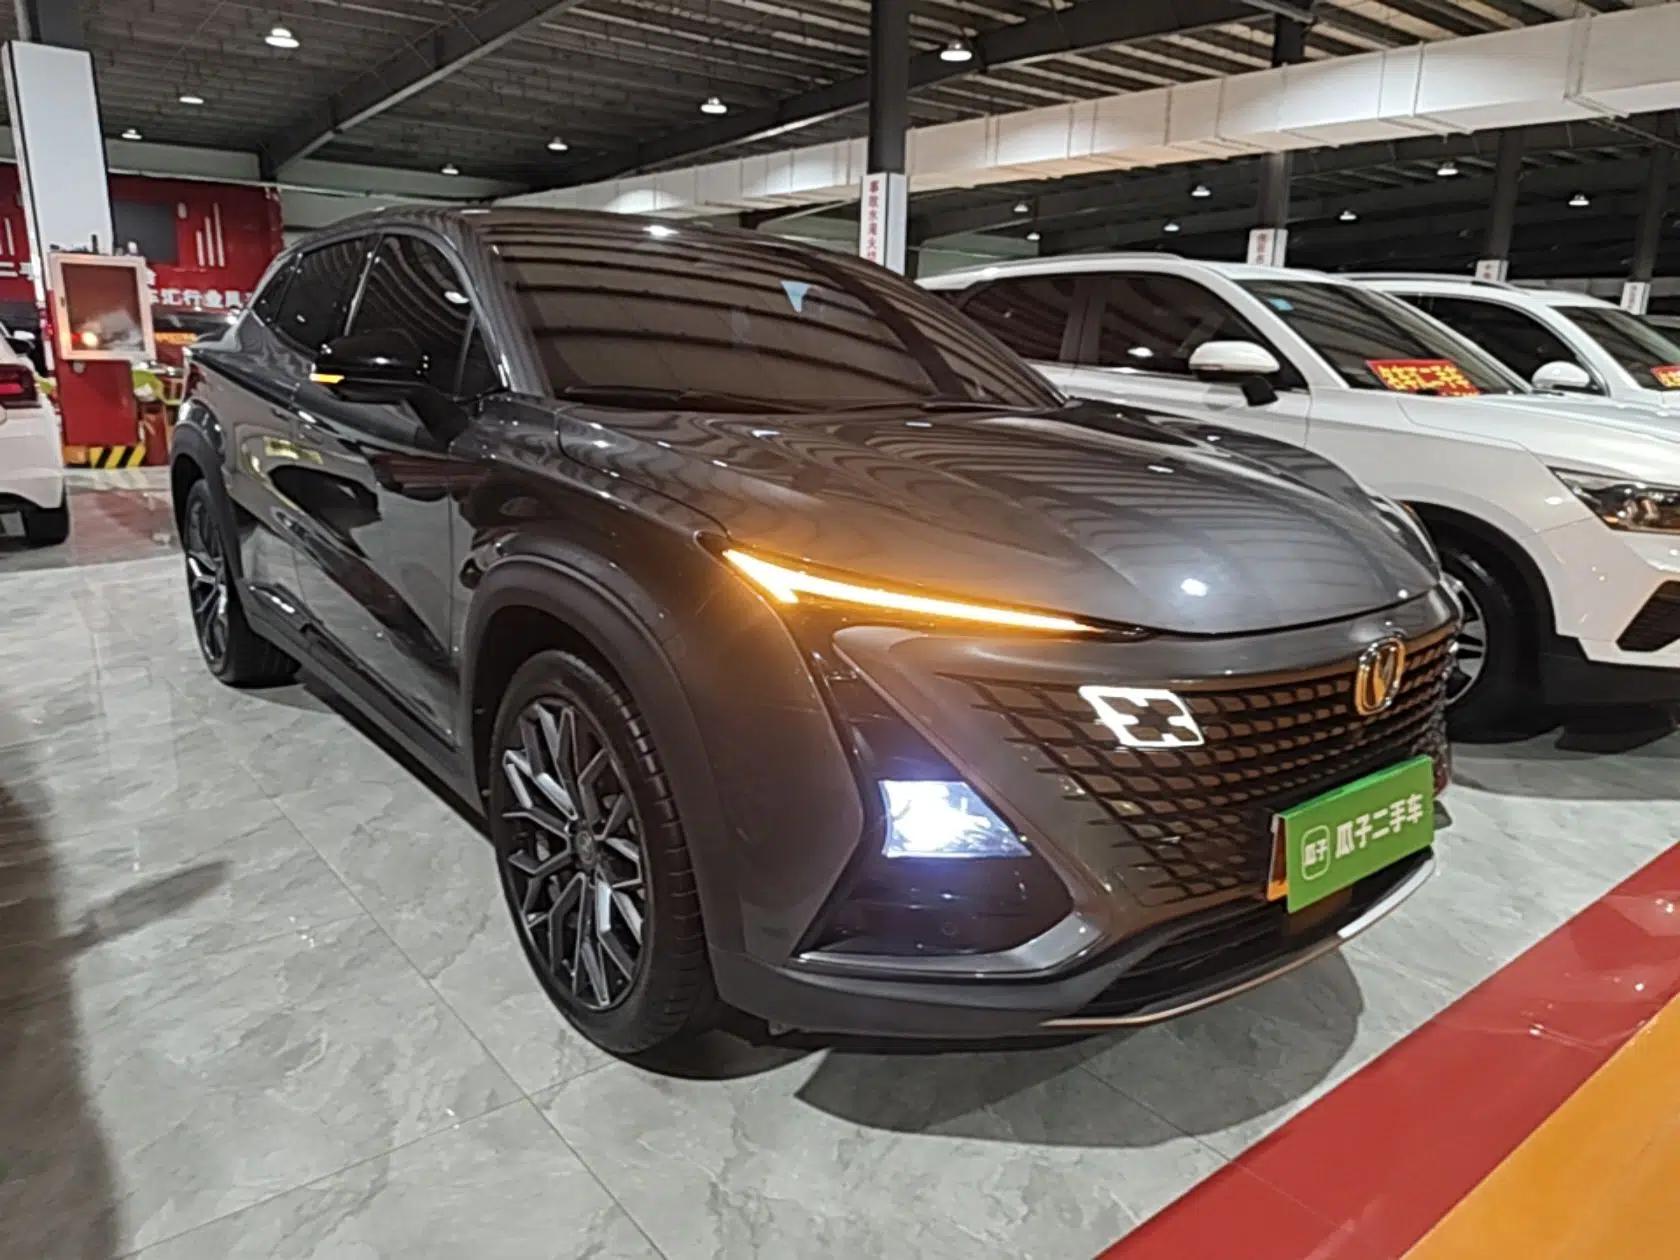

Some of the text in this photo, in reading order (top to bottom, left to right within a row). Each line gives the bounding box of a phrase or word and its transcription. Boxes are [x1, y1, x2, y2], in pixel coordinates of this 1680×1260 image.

[1335, 794, 1423, 859] 瓜子二手车
